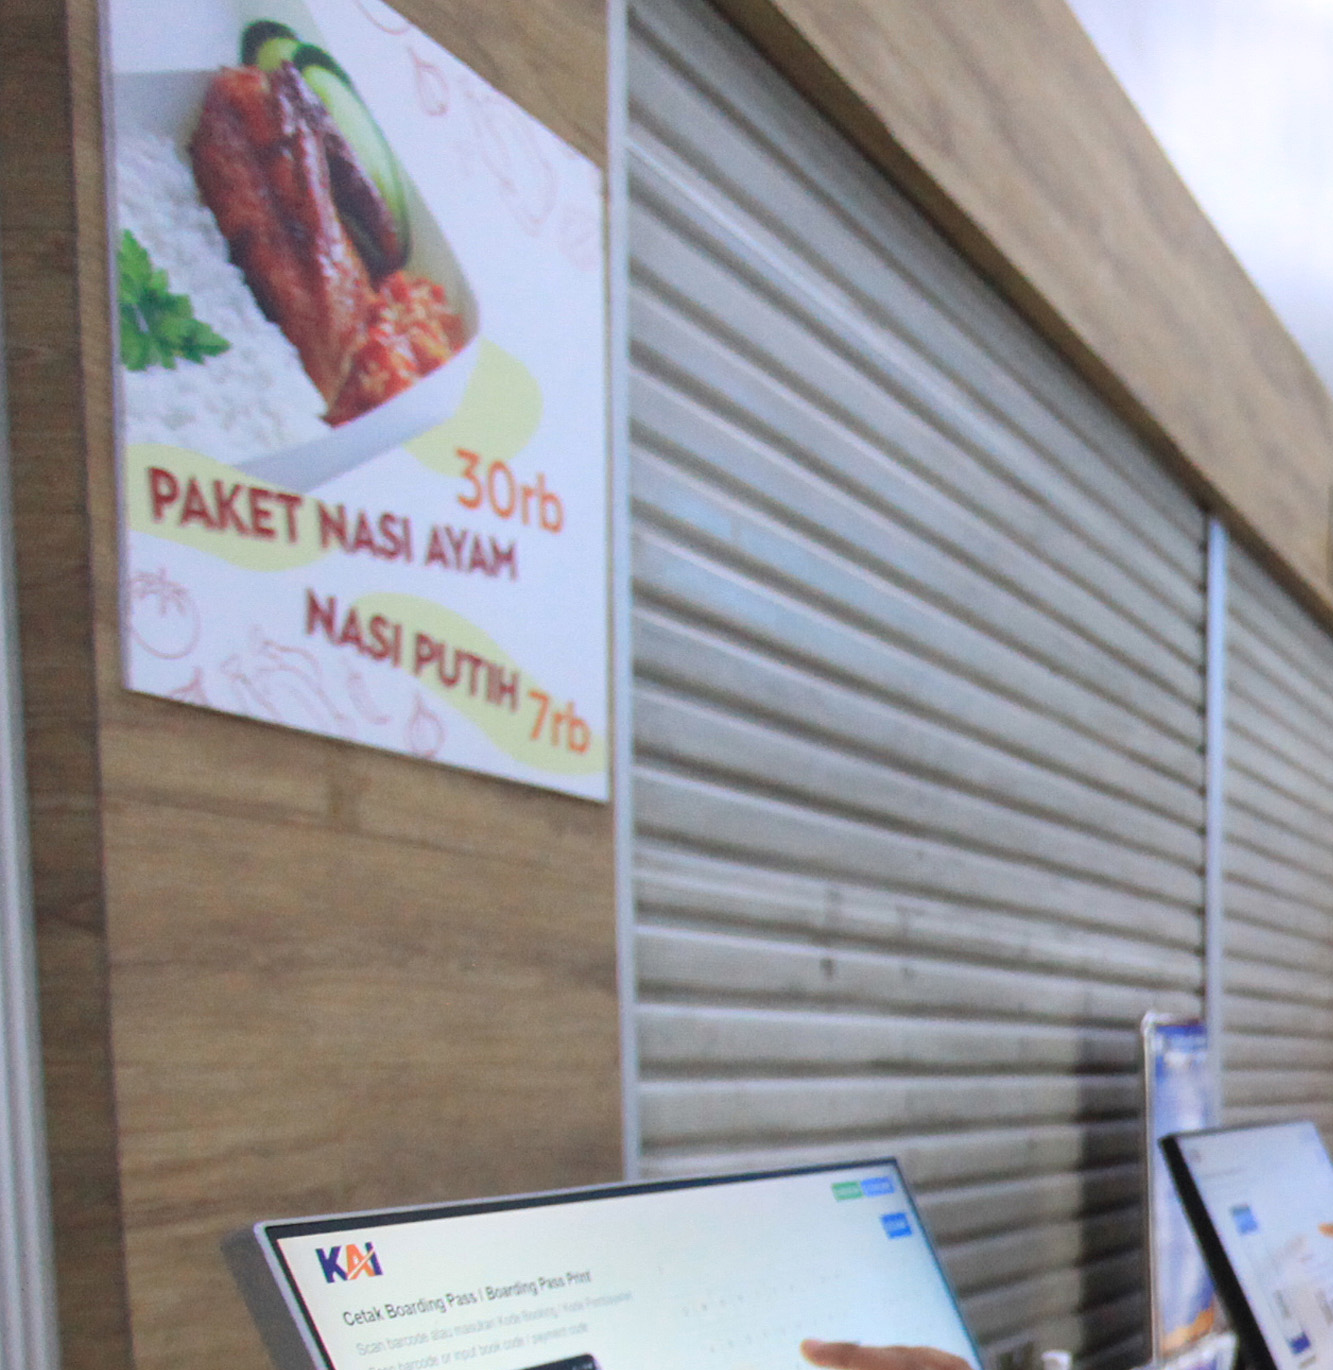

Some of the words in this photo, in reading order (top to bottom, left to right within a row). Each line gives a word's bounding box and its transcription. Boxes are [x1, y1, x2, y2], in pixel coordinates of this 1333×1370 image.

[147, 467, 304, 545] PAKET
[316, 502, 412, 564] NASI
[424, 524, 518, 581] AYAM
[456, 448, 563, 534] 30rb
[305, 589, 404, 667] NASI
[414, 632, 520, 712] PUTIH
[527, 690, 591, 754] 7rb
[316, 1242, 383, 1283] KAI
[343, 1306, 385, 1326] Cetak
[384, 1298, 447, 1319] Boarding
[445, 1291, 477, 1307] Pass
[485, 1280, 538, 1301] Boarding
[538, 1276, 565, 1290] Pass
[566, 1270, 592, 1286] Print
[356, 1341, 385, 1356] Scan
[386, 1332, 430, 1350] barcode
